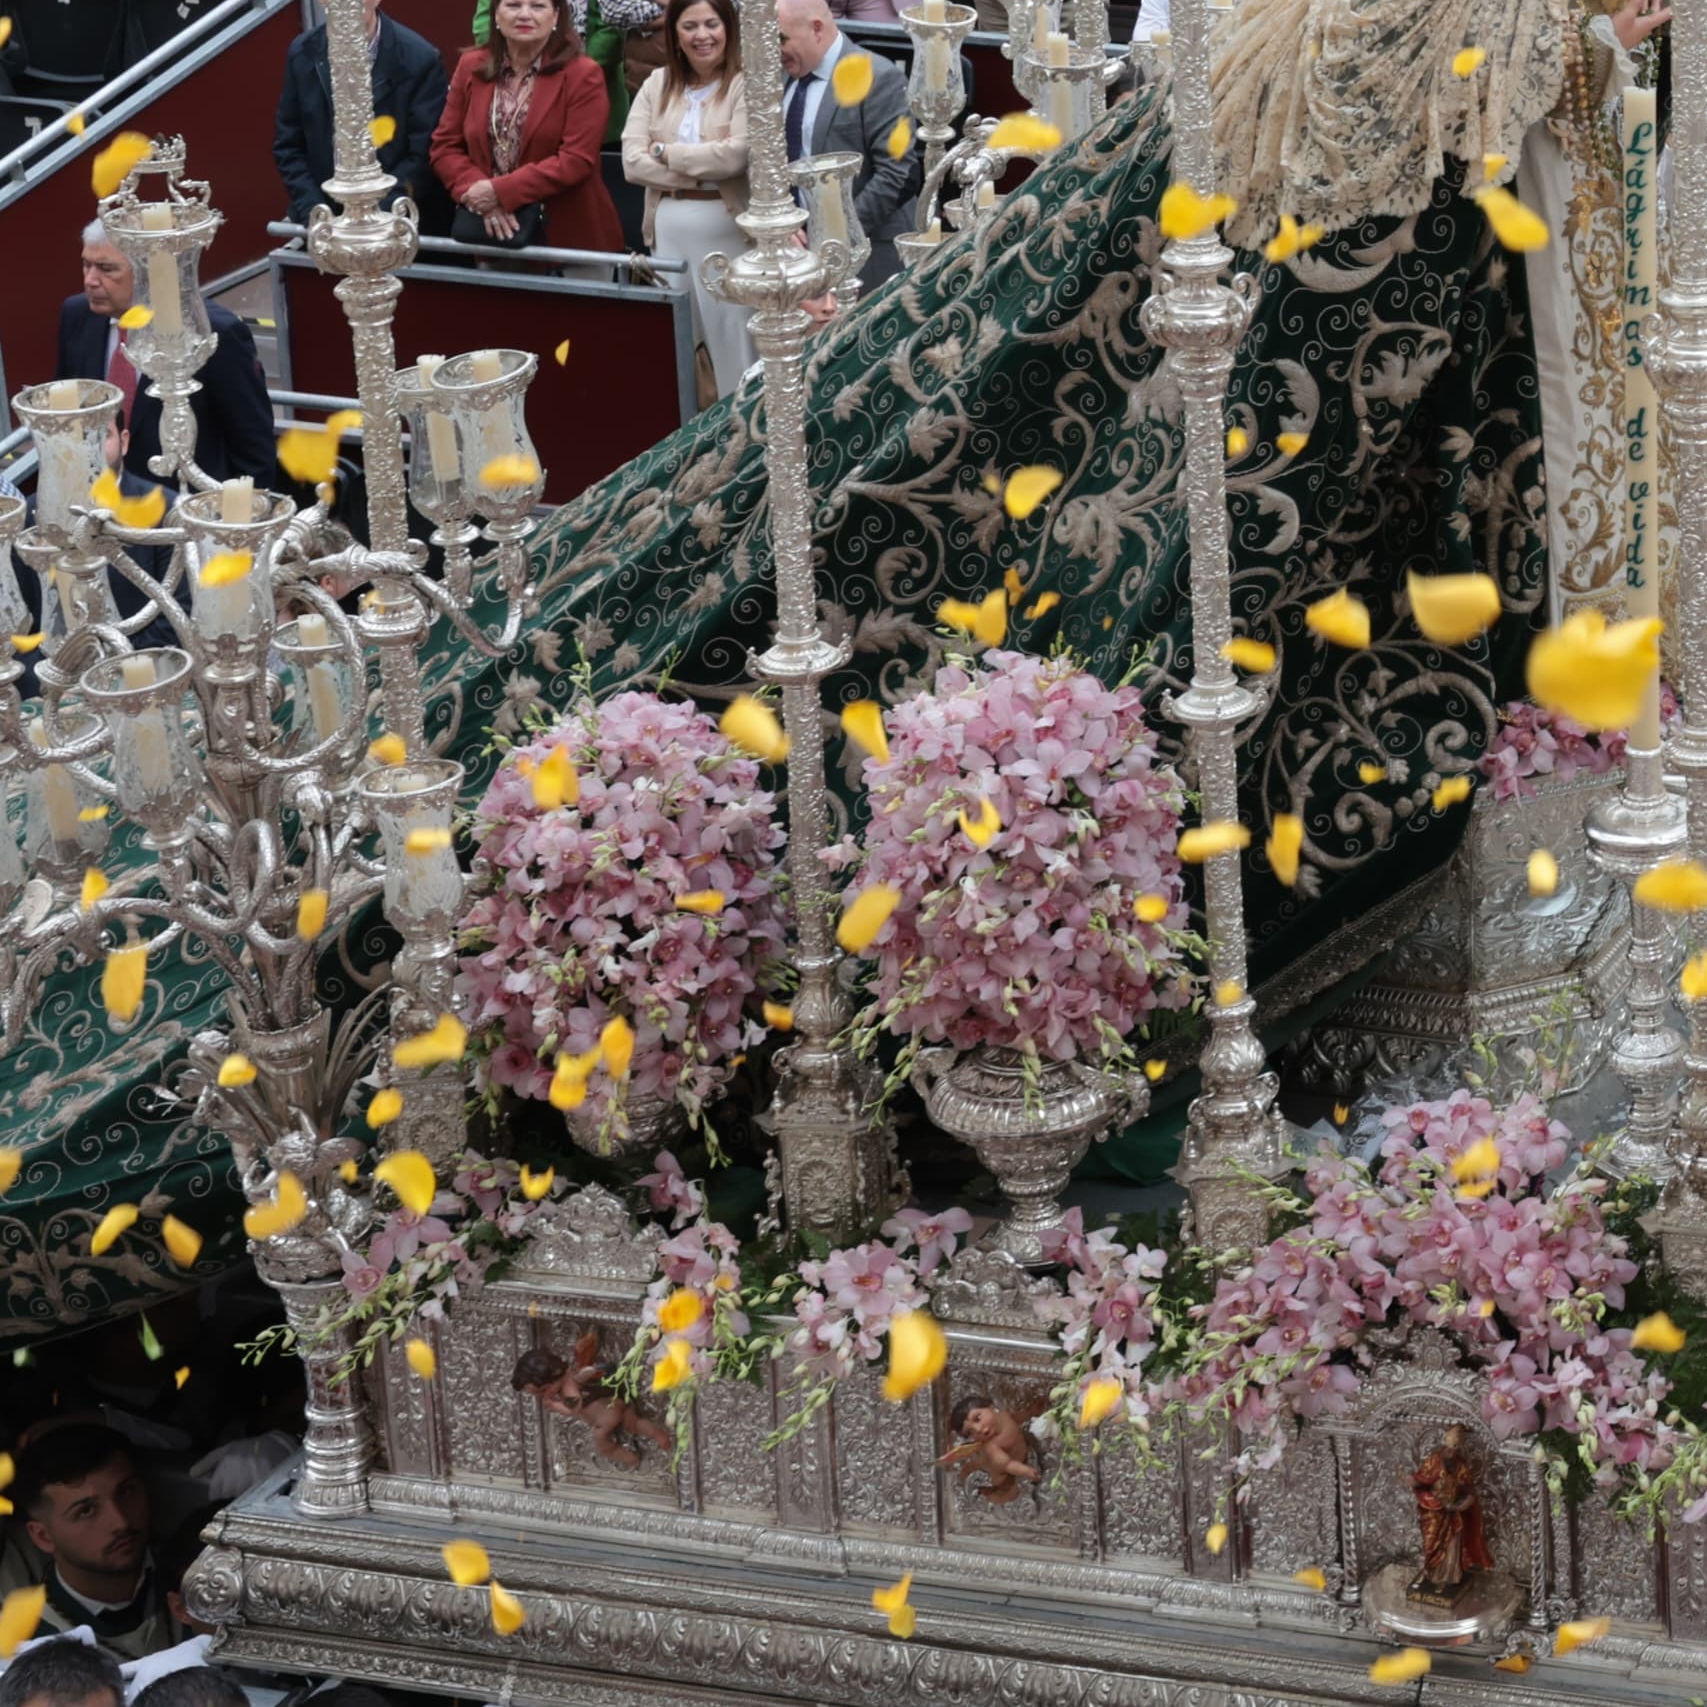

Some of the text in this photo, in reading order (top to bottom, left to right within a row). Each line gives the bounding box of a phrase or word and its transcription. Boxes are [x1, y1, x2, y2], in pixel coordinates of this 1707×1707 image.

[1625, 121, 1653, 589] Lágrimas de vida
